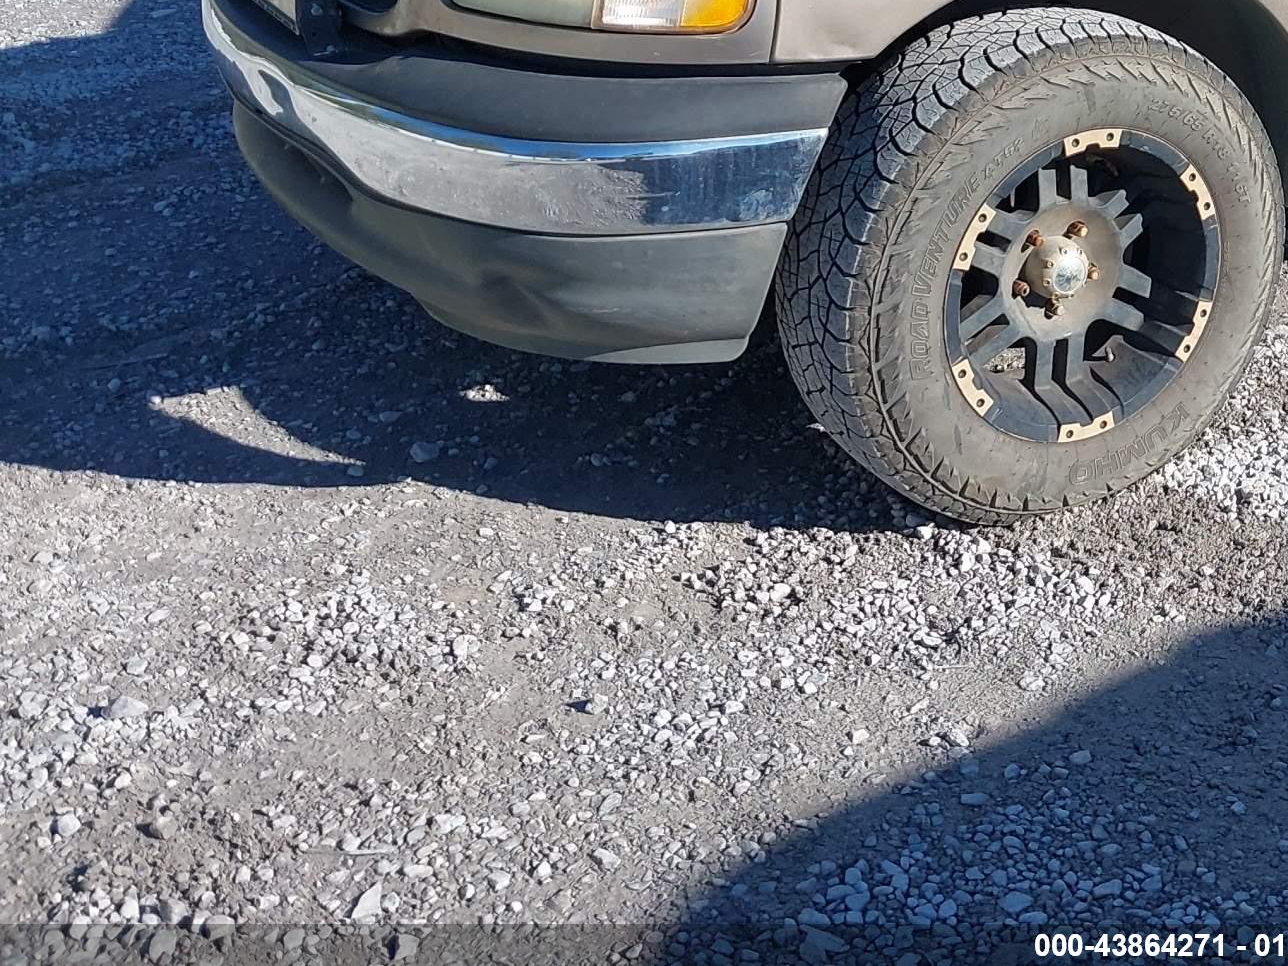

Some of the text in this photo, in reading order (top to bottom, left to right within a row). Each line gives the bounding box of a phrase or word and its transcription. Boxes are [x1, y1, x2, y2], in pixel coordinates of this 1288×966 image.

[1147, 98, 1207, 132] 275/65
[912, 172, 982, 297] VENTURE
[909, 305, 932, 380] ROAD
[1069, 401, 1190, 486] KUMHO
